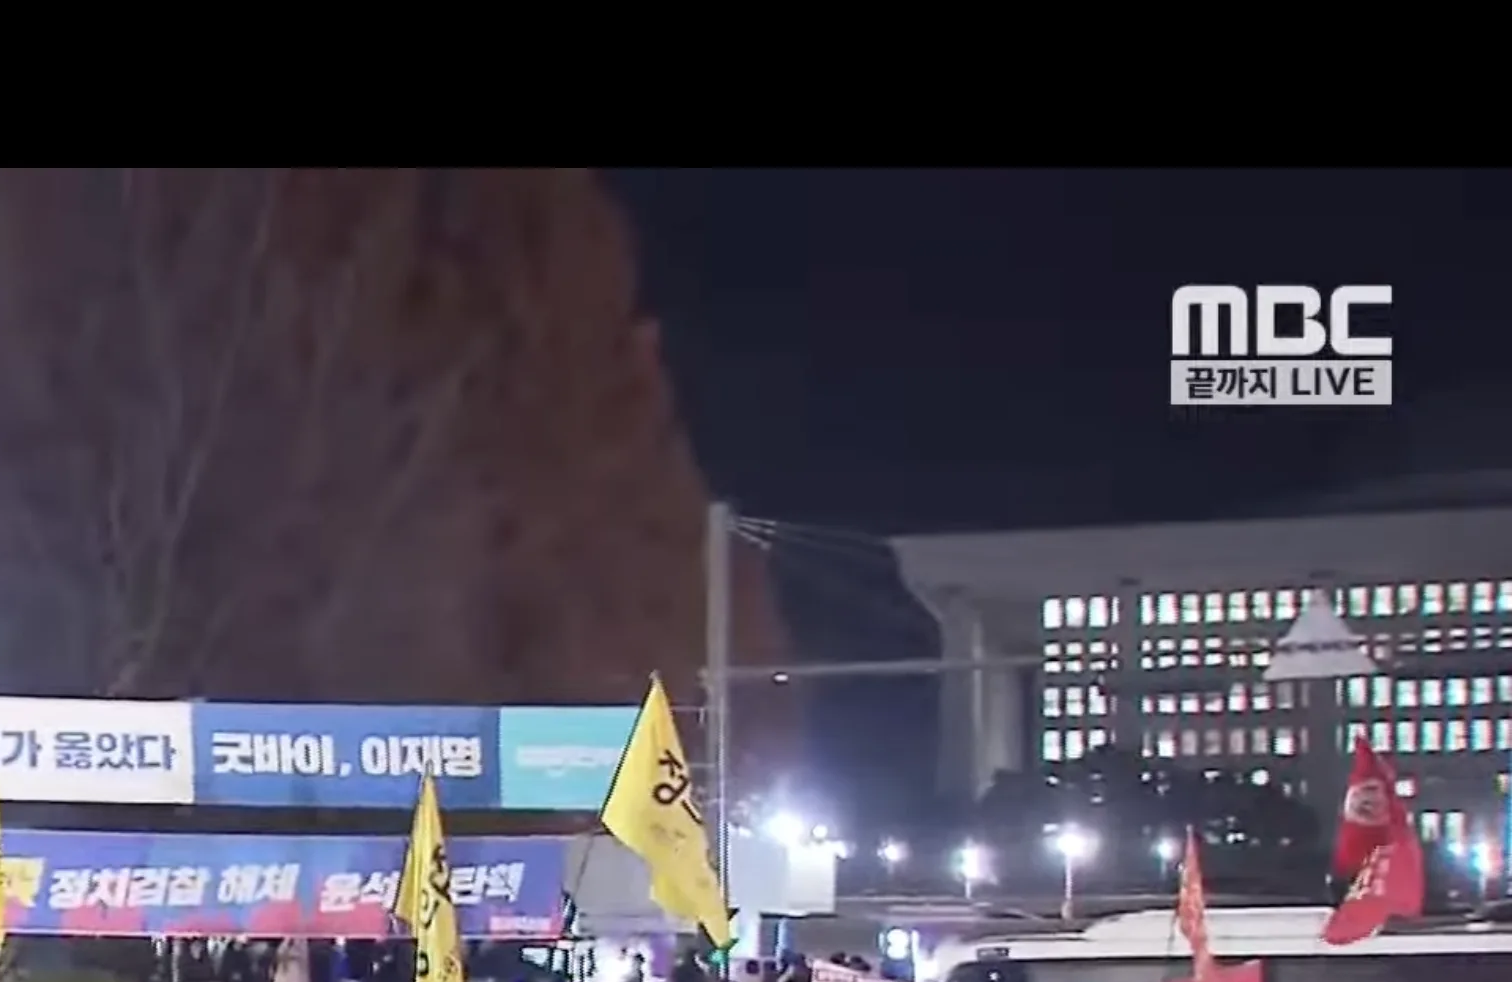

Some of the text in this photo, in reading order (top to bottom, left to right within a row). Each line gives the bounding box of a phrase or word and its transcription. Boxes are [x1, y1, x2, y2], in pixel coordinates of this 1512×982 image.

[53, 731, 176, 771] 옳았다
[211, 732, 351, 777] 굿바이,
[360, 735, 482, 777] 이재명
[48, 866, 210, 910] 정치검찰
